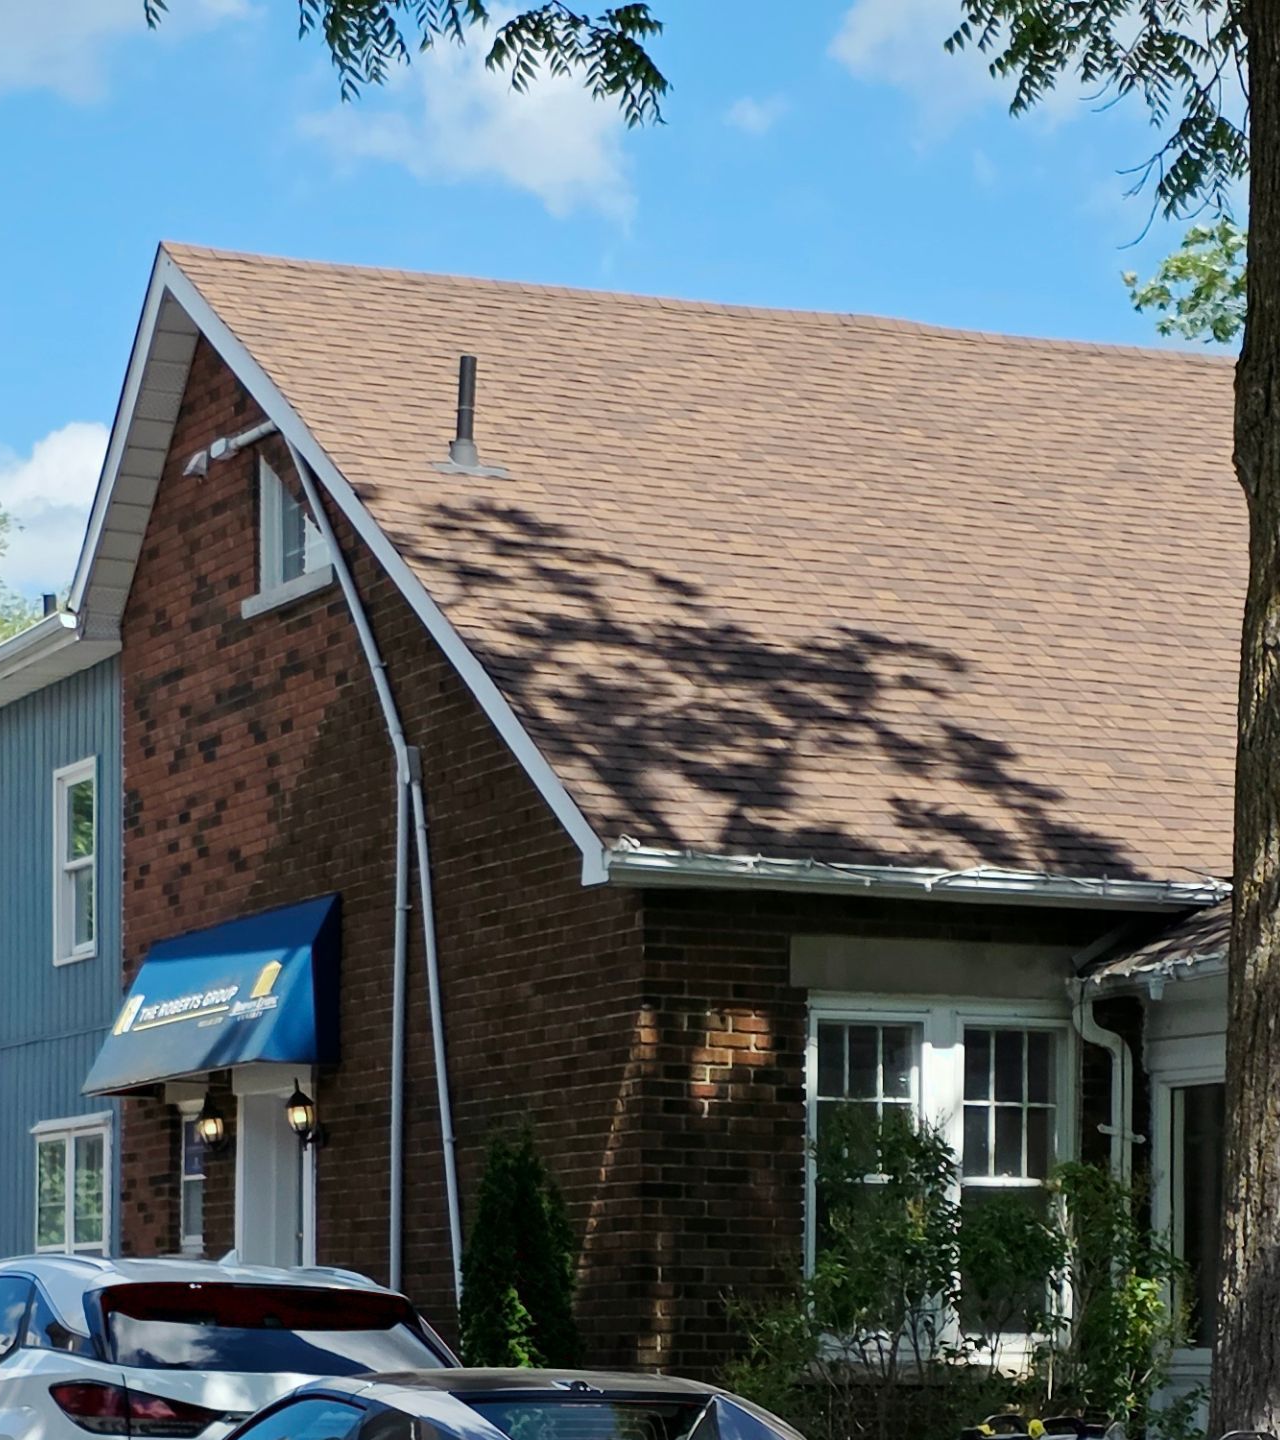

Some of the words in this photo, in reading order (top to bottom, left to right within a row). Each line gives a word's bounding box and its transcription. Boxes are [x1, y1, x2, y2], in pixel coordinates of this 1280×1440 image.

[140, 1005, 160, 1022] THE
[158, 994, 204, 1018] ROBERTS
[203, 985, 239, 1007] GROUP
